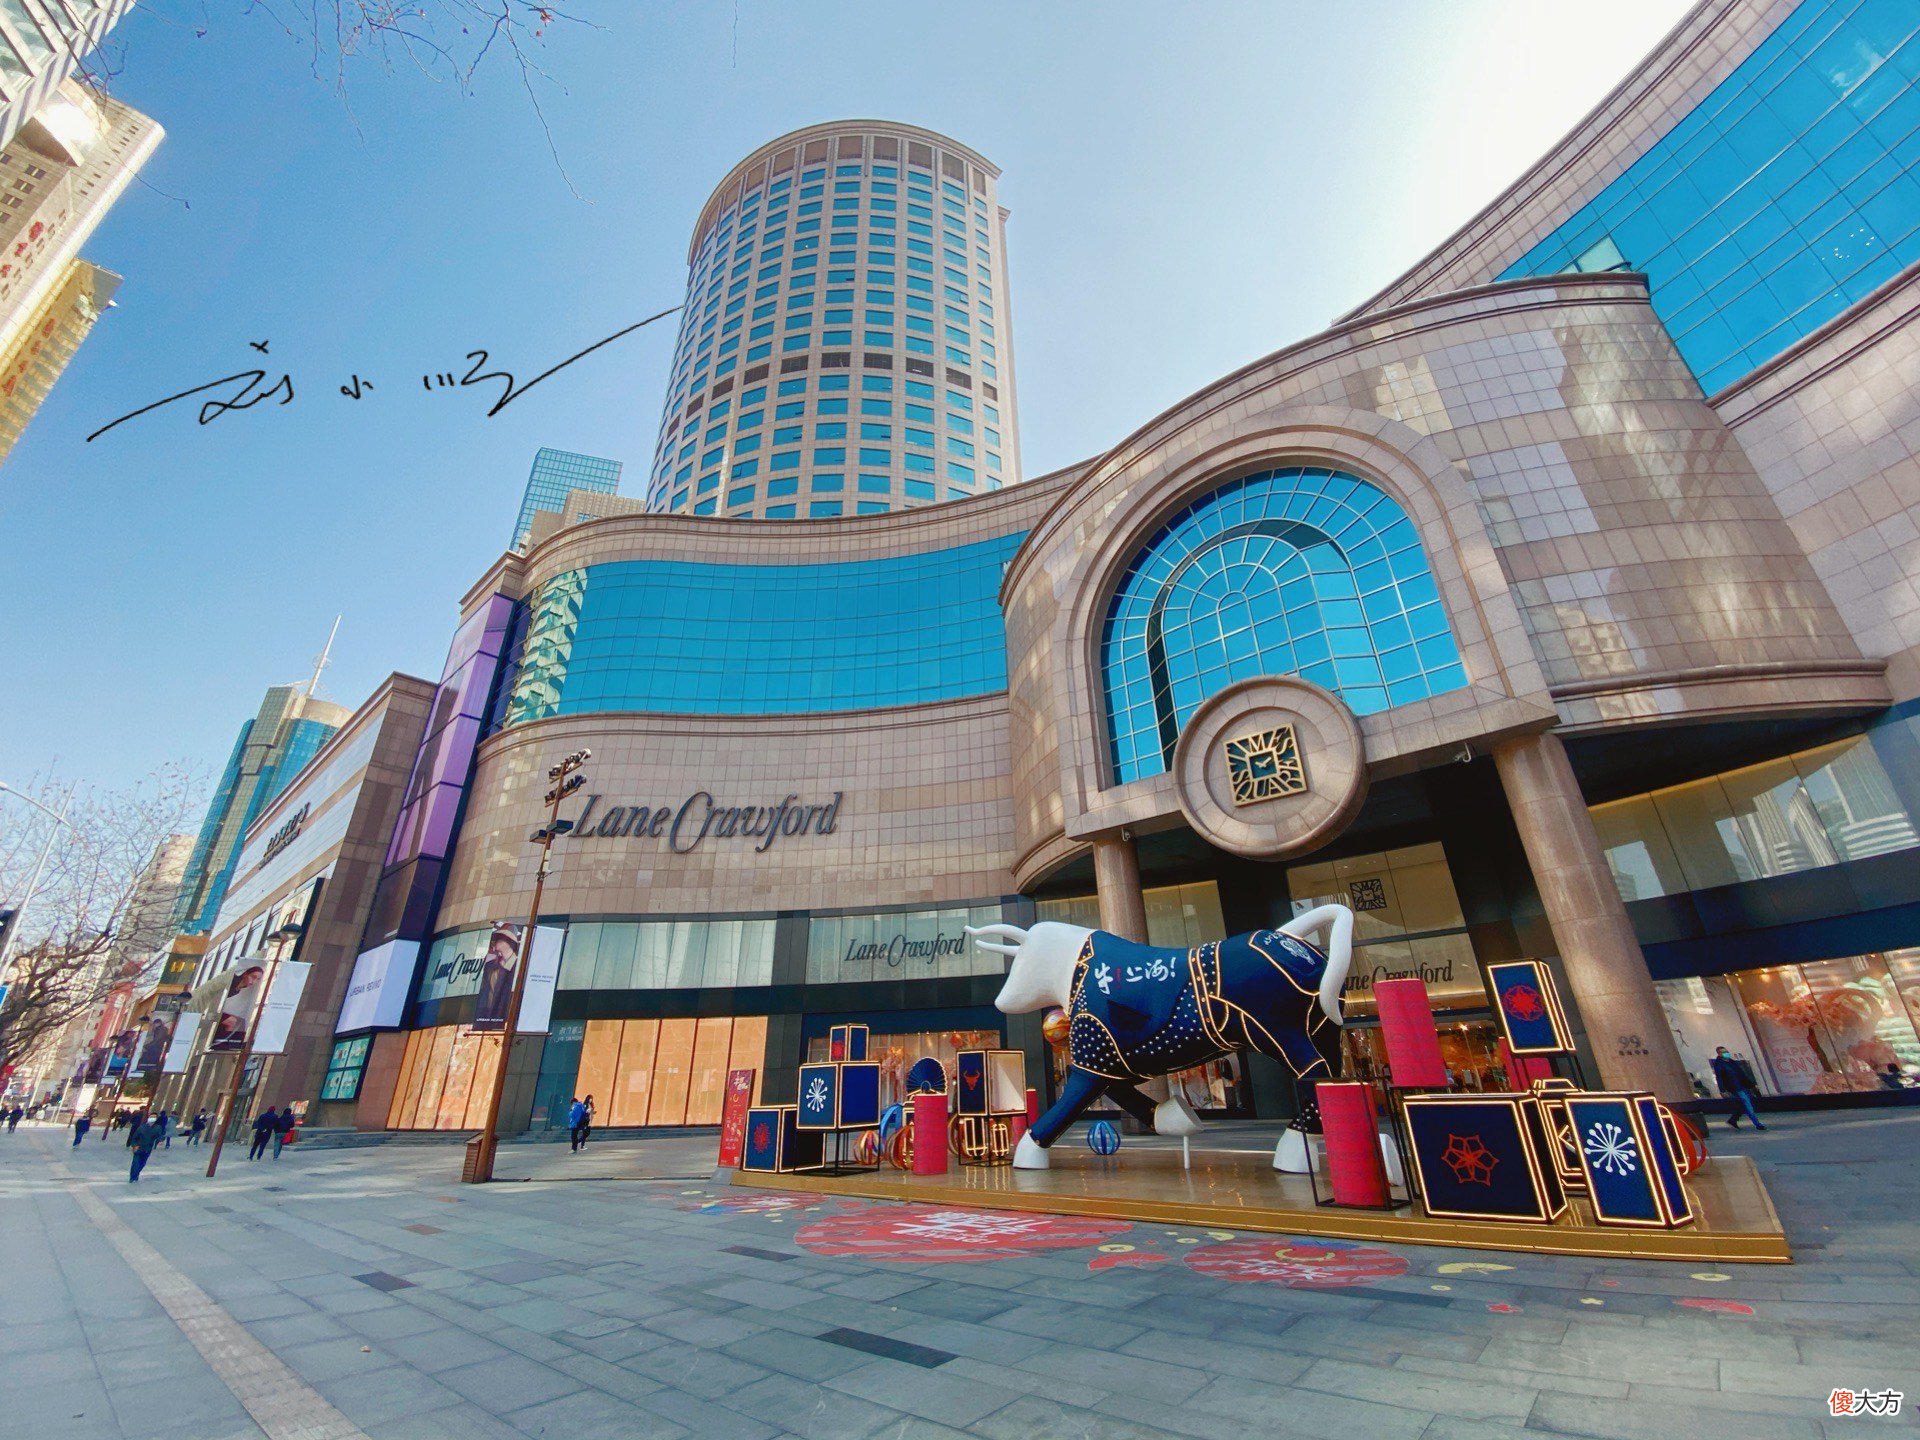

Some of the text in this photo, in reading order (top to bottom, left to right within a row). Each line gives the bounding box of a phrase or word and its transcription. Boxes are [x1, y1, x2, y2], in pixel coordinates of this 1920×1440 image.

[568, 791, 843, 853] Lane Crawford
[844, 931, 966, 967] Lane Crawford
[1345, 973, 1370, 991] ane
[1777, 1056, 1819, 1074] CNY
